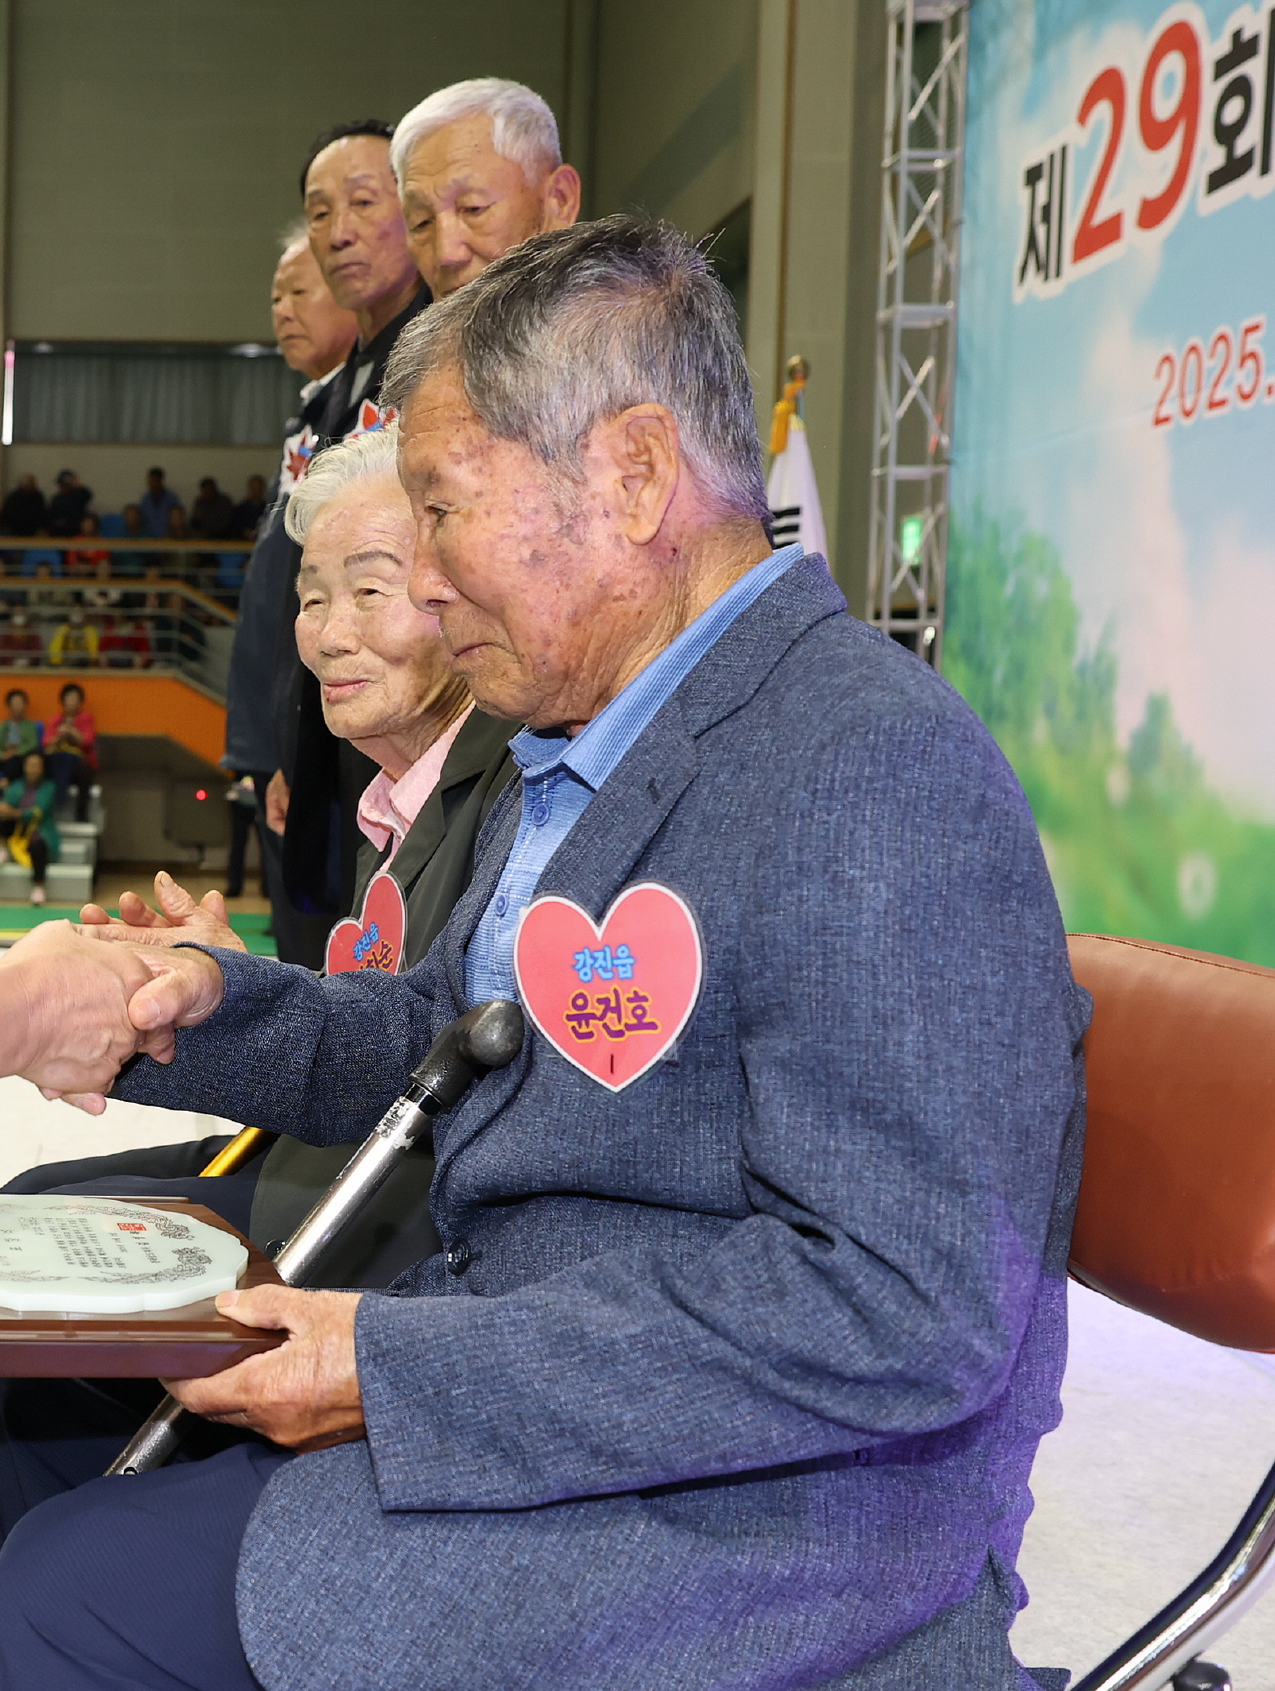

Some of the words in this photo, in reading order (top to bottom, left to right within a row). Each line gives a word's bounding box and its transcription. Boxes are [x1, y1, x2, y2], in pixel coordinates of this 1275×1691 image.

[1018, 6, 1275, 288] 제29회
[353, 922, 379, 962] 강진읍
[572, 944, 636, 982] 강진읍
[564, 984, 660, 1041] 윤건호
